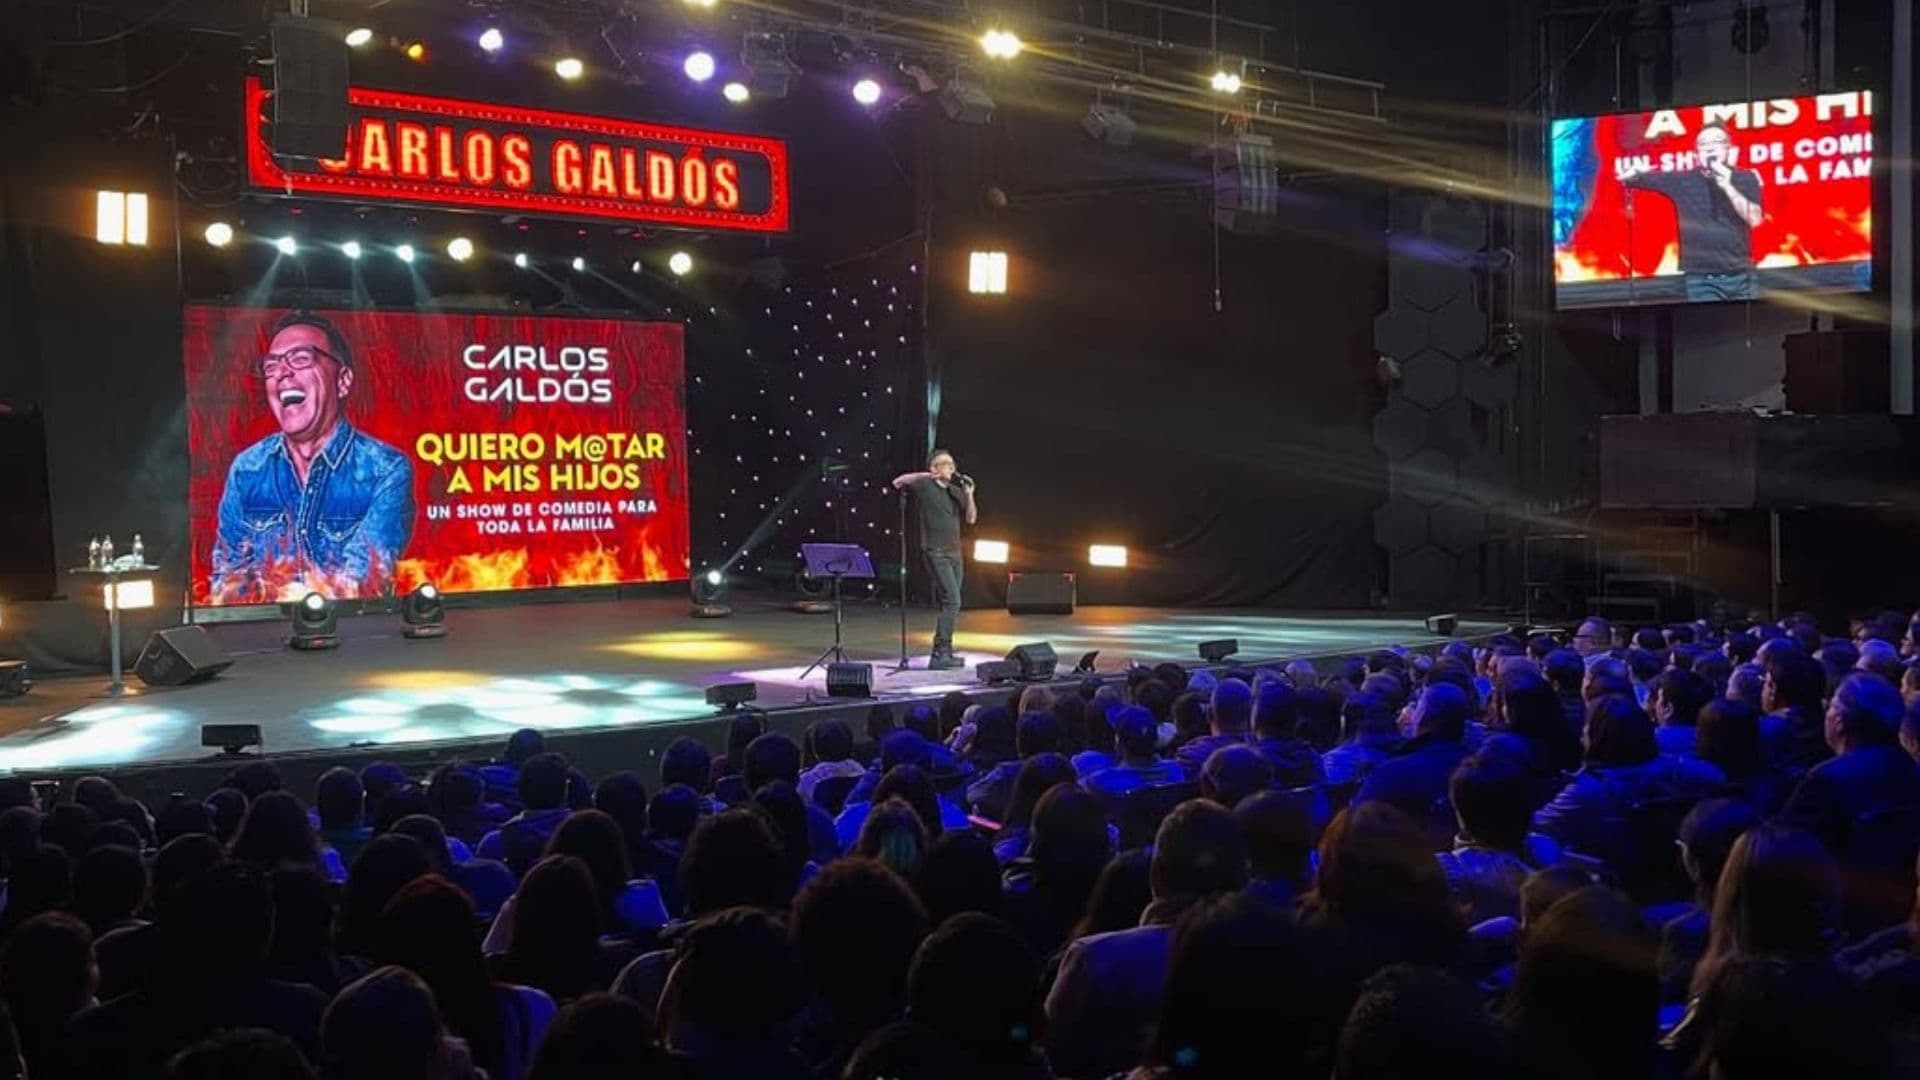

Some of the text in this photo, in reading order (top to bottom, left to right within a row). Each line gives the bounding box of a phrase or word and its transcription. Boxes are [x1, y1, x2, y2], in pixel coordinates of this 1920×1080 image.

[1645, 109, 1687, 138] A
[1702, 98, 1800, 130] MIS
[1749, 142, 1784, 164] DE
[1794, 132, 1872, 159] COM
[318, 118, 741, 211] ARLOS GALDÓS
[1775, 163, 1809, 186] LA
[463, 345, 609, 371] CARLOS
[464, 373, 612, 403] GALDÓS
[416, 433, 665, 465] QUIERO M@TAR
[447, 464, 641, 493] A MIS HIJOS
[427, 499, 658, 519] UN SHOW DE COMEDIA PARA
[477, 517, 615, 534] TODA LA FAMILIA
